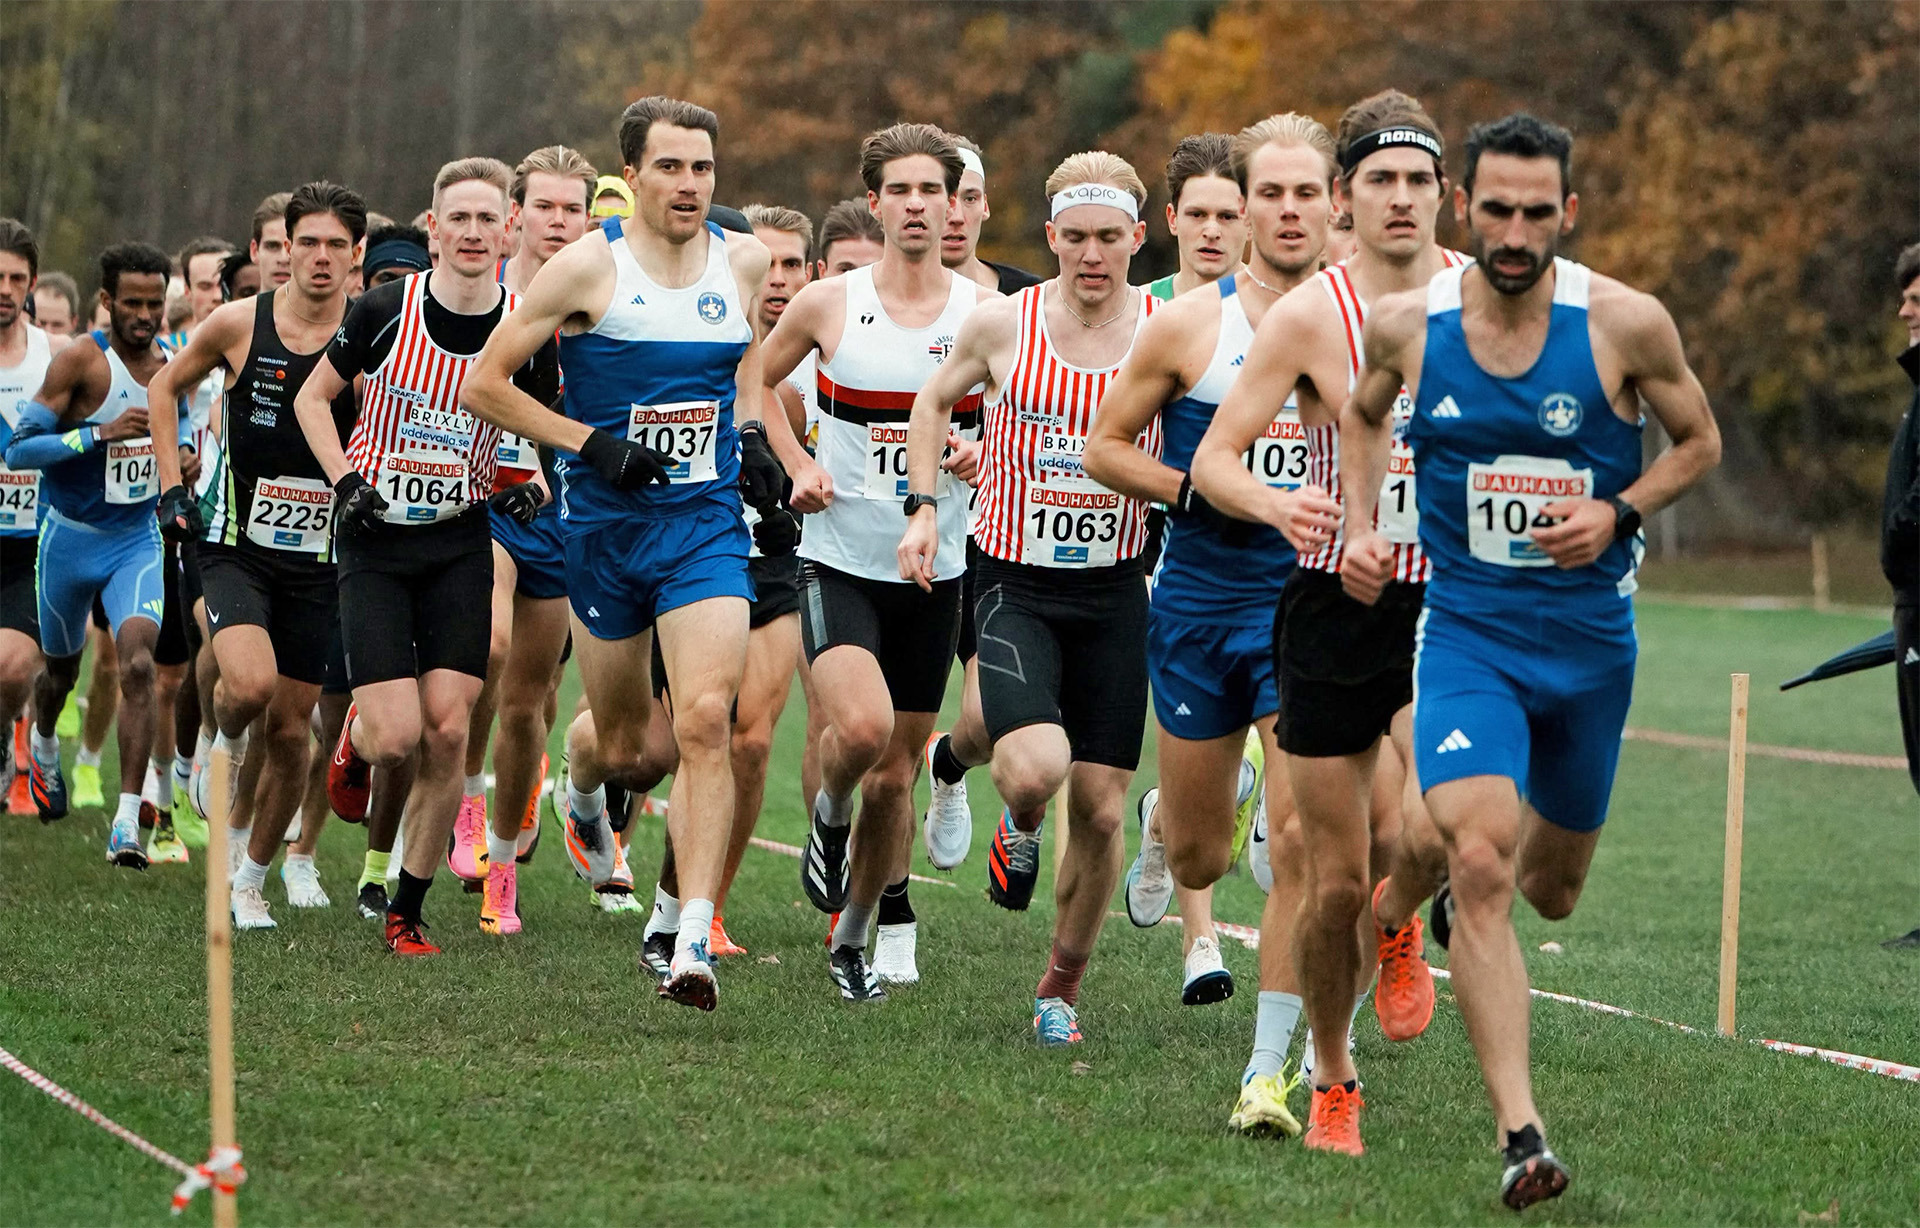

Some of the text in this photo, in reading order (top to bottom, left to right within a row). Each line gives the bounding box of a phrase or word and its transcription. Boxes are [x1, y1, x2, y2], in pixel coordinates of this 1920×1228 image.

[257, 356, 288, 366] noname
[389, 387, 417, 400] CRAFT
[410, 407, 473, 431] BRIXLY
[634, 407, 714, 424] BAUHAUS
[1021, 413, 1053, 424] CRAFT
[401, 427, 470, 448] uddevalla.se
[633, 425, 714, 458] 1037
[388, 457, 464, 477] BAUHAUS
[259, 483, 332, 505] BAUHAUS
[387, 474, 465, 506] 1064
[1474, 473, 1585, 496] BAUHAUS
[1031, 488, 1119, 509] BAUHAUS
[253, 500, 330, 531] 2225
[1031, 508, 1118, 543] 1063
